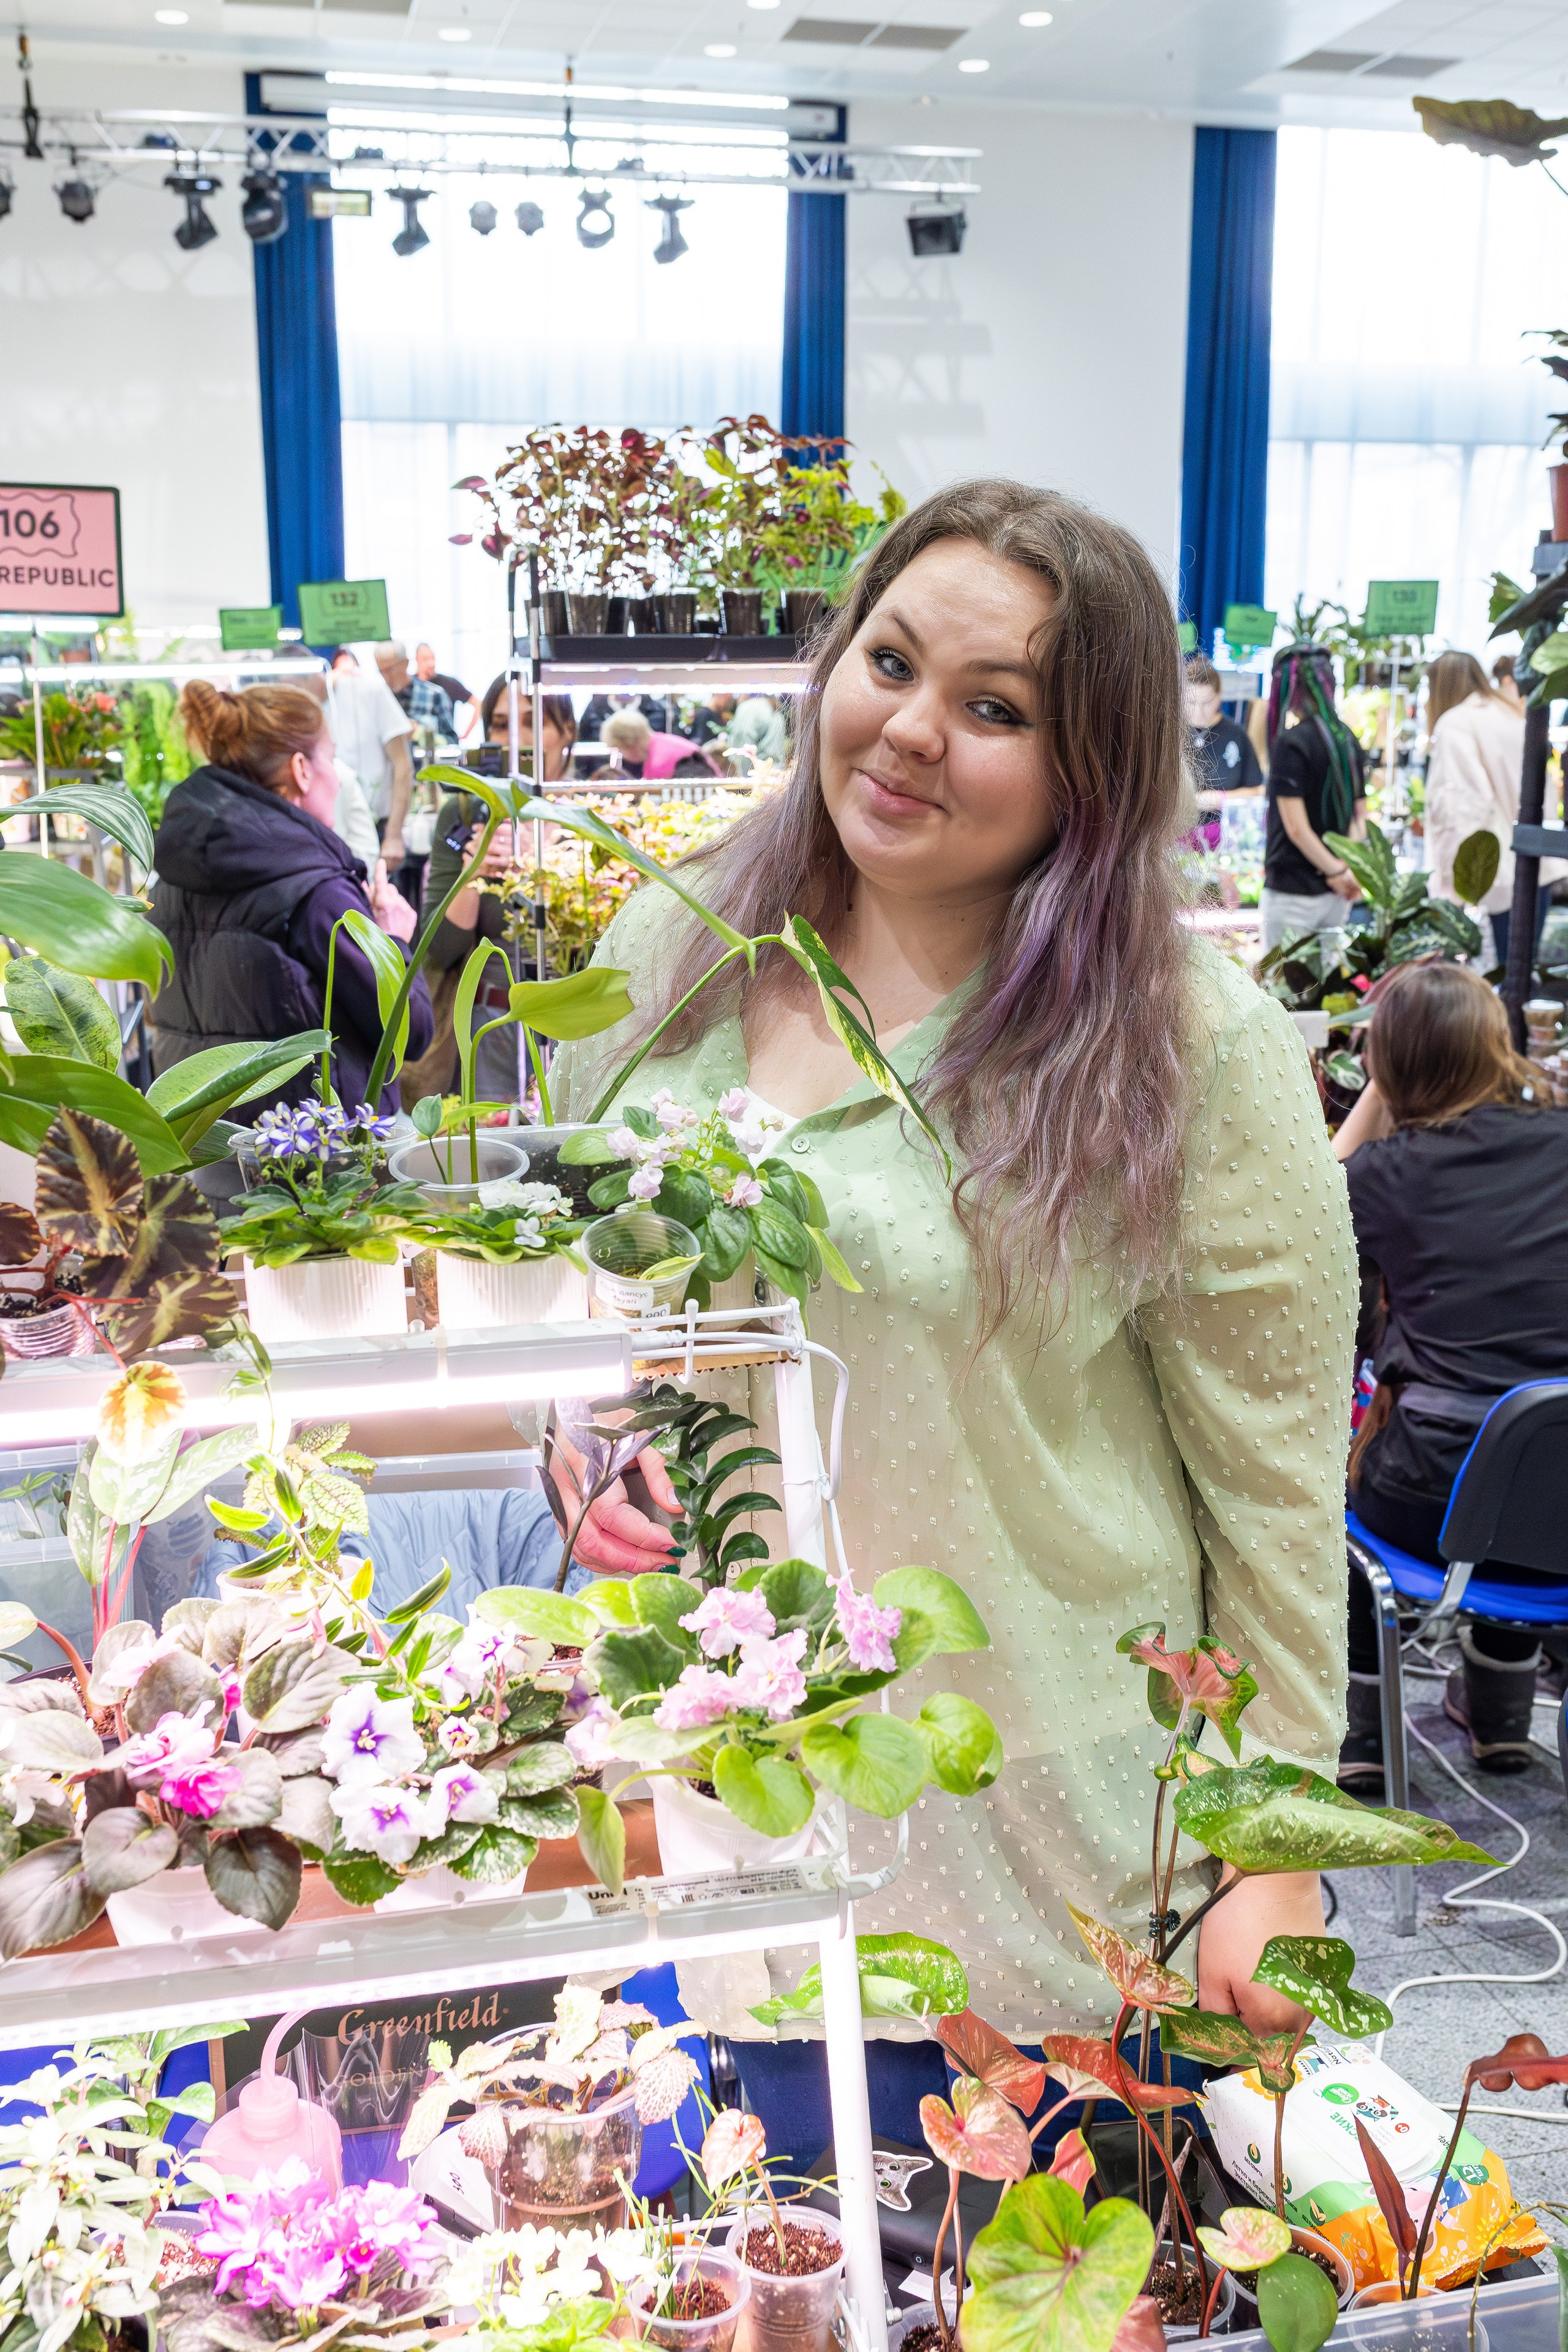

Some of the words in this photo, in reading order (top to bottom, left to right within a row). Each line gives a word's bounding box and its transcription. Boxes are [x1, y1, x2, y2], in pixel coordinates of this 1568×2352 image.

[0, 509, 59, 539] 106
[0, 565, 114, 587] REPUBLIC
[588, 1887, 628, 1900] Unil
[338, 1991, 502, 2046] Greenfield
[1232, 2160, 1248, 2179] Легко
[1462, 2165, 1481, 2181] 12
